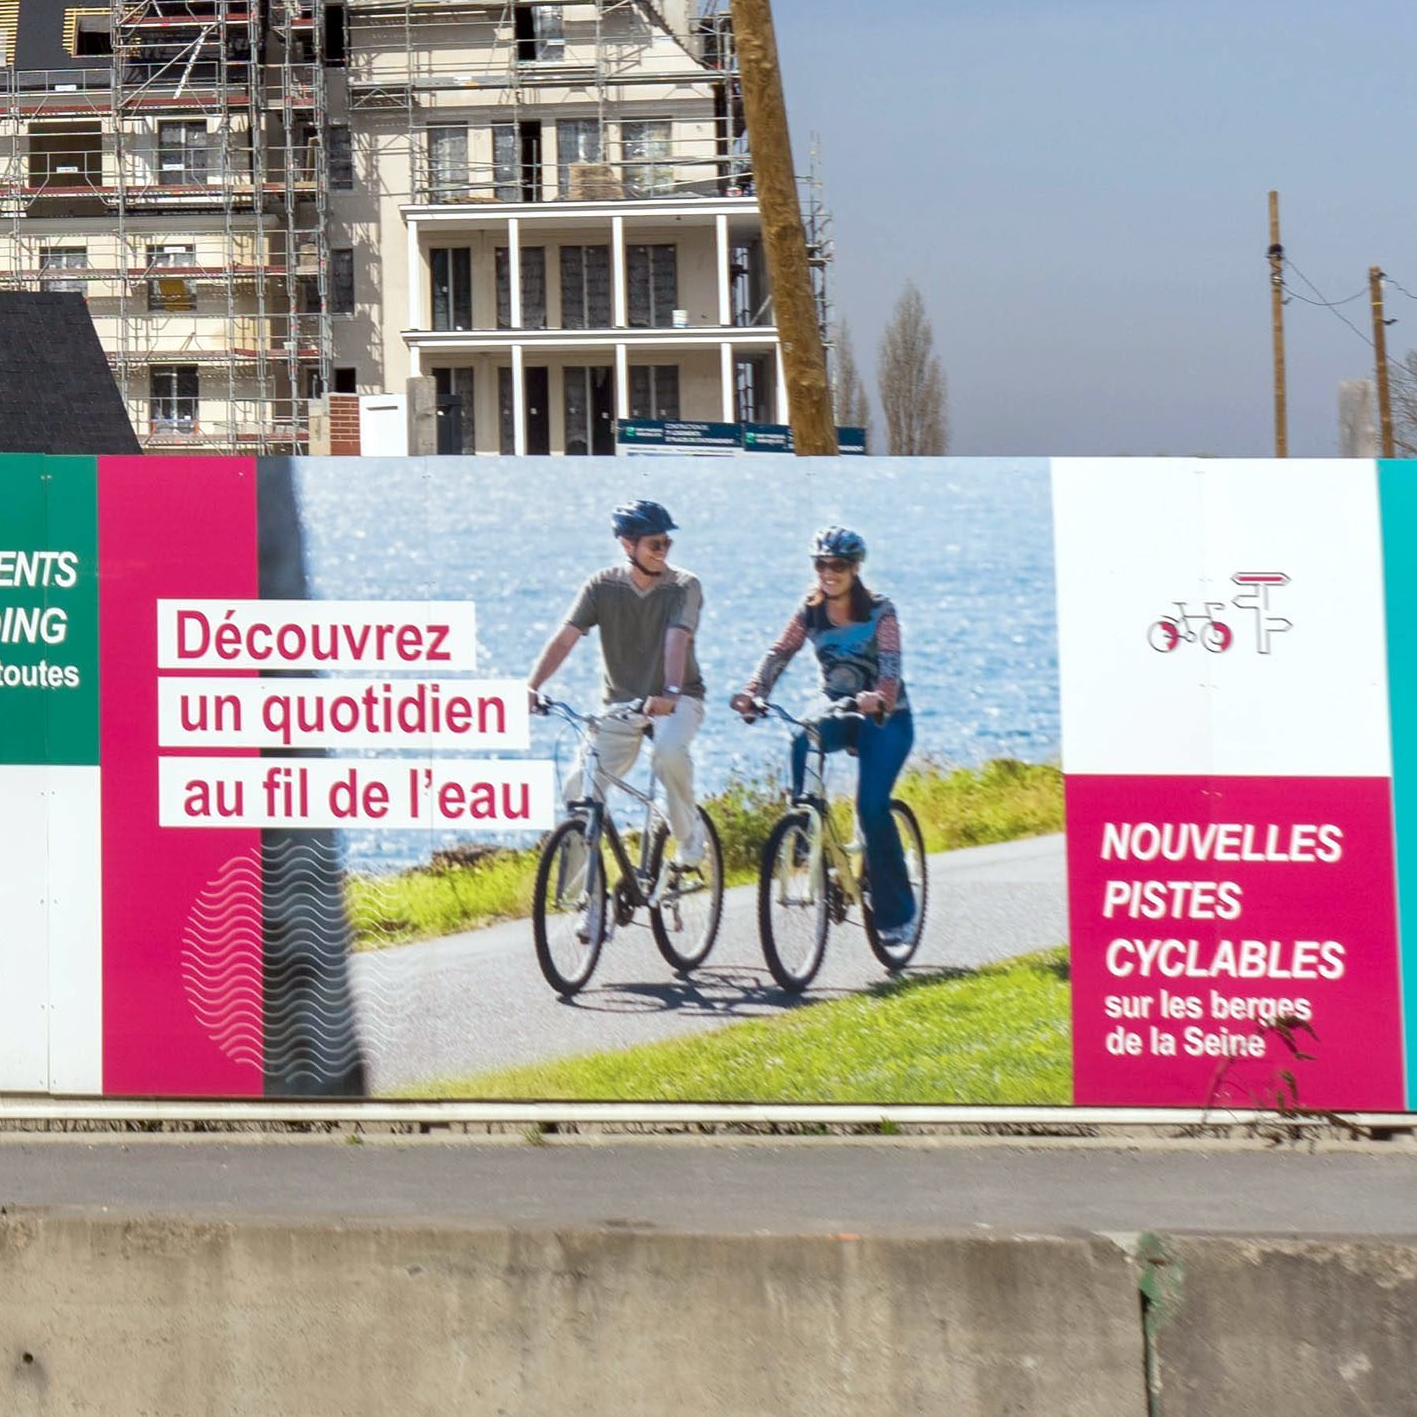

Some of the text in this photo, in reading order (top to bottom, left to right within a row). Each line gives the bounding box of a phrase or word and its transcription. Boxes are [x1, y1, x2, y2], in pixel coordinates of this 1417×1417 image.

[177, 609, 451, 662] Découvrez
[181, 684, 506, 745] un quotidien
[184, 767, 530, 820] au fil de l'eau
[1101, 823, 1344, 863] NOUVELLES
[1103, 880, 1243, 920] PISTES
[1106, 938, 1346, 980] CYCLABLES
[1105, 988, 1313, 1027] sur les berges
[1106, 1025, 1266, 1058] de la Seine
